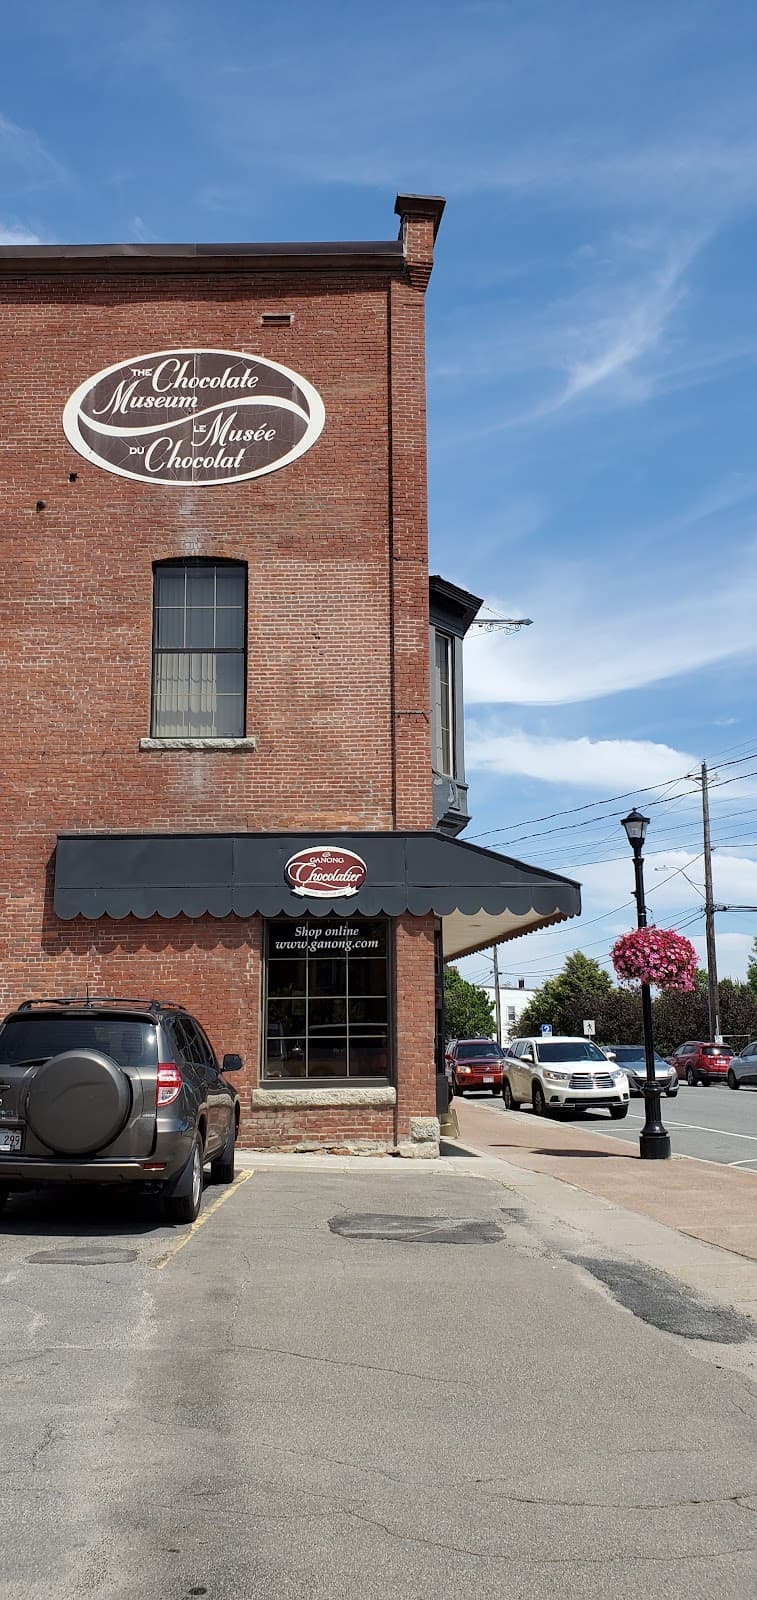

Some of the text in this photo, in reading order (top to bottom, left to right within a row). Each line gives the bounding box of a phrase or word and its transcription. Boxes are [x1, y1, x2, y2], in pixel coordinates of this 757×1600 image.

[131, 358, 259, 393] THE Chocolate
[92, 378, 198, 415] Museum
[191, 409, 276, 447] LE Musée
[129, 437, 246, 473] DU Chocolat
[288, 862, 364, 884] Chocolatier
[275, 940, 379, 952] www.ganong.com
[295, 925, 359, 939] Shop online
[4, 1135, 20, 1146] 299
